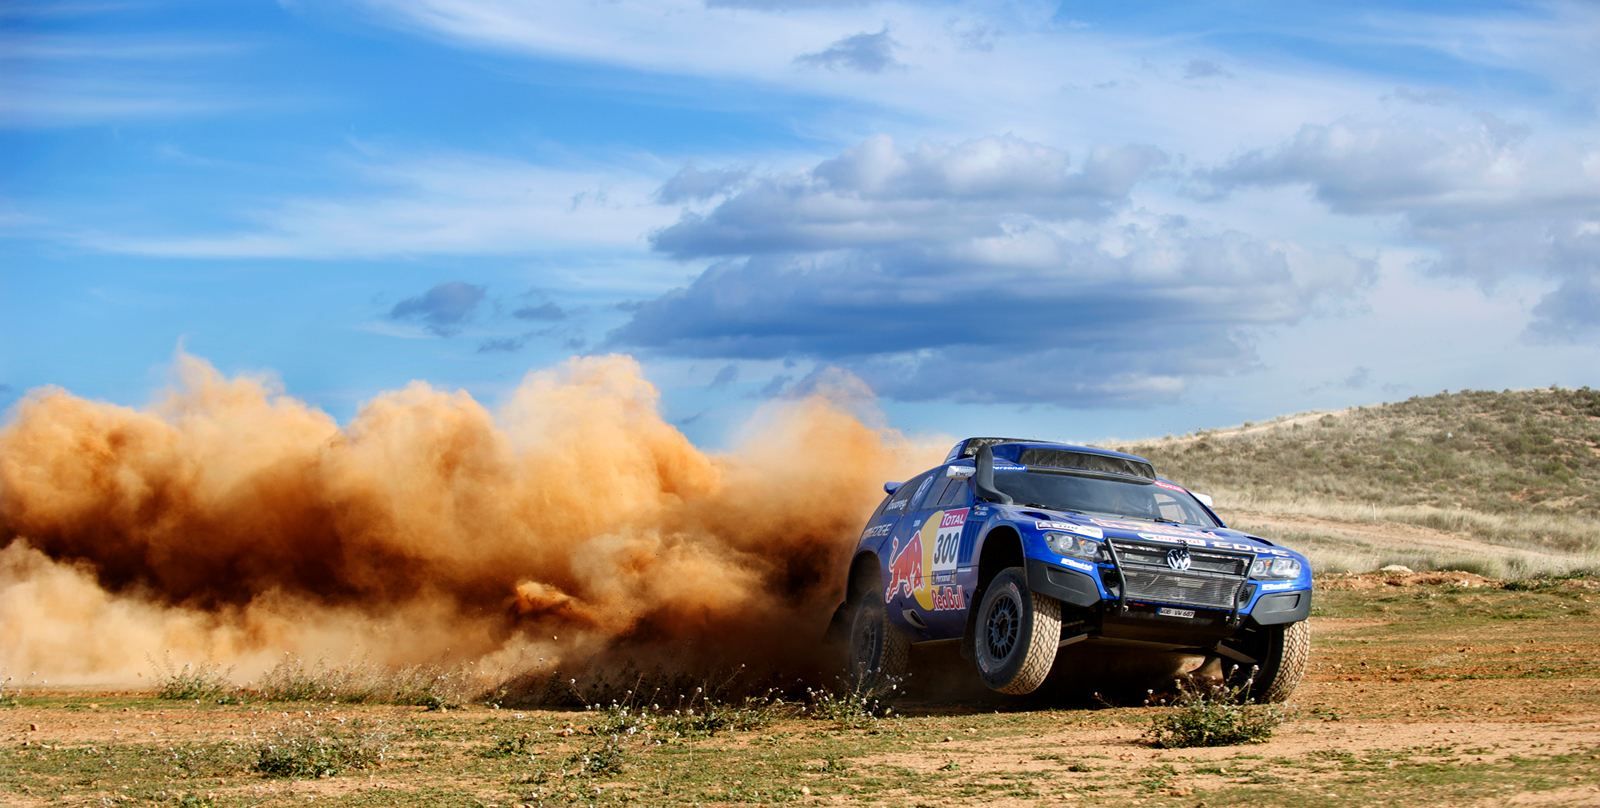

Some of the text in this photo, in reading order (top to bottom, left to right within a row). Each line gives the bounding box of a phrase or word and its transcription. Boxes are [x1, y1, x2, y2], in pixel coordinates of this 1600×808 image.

[933, 532, 960, 564] 300
[931, 585, 966, 611] Red Bull
